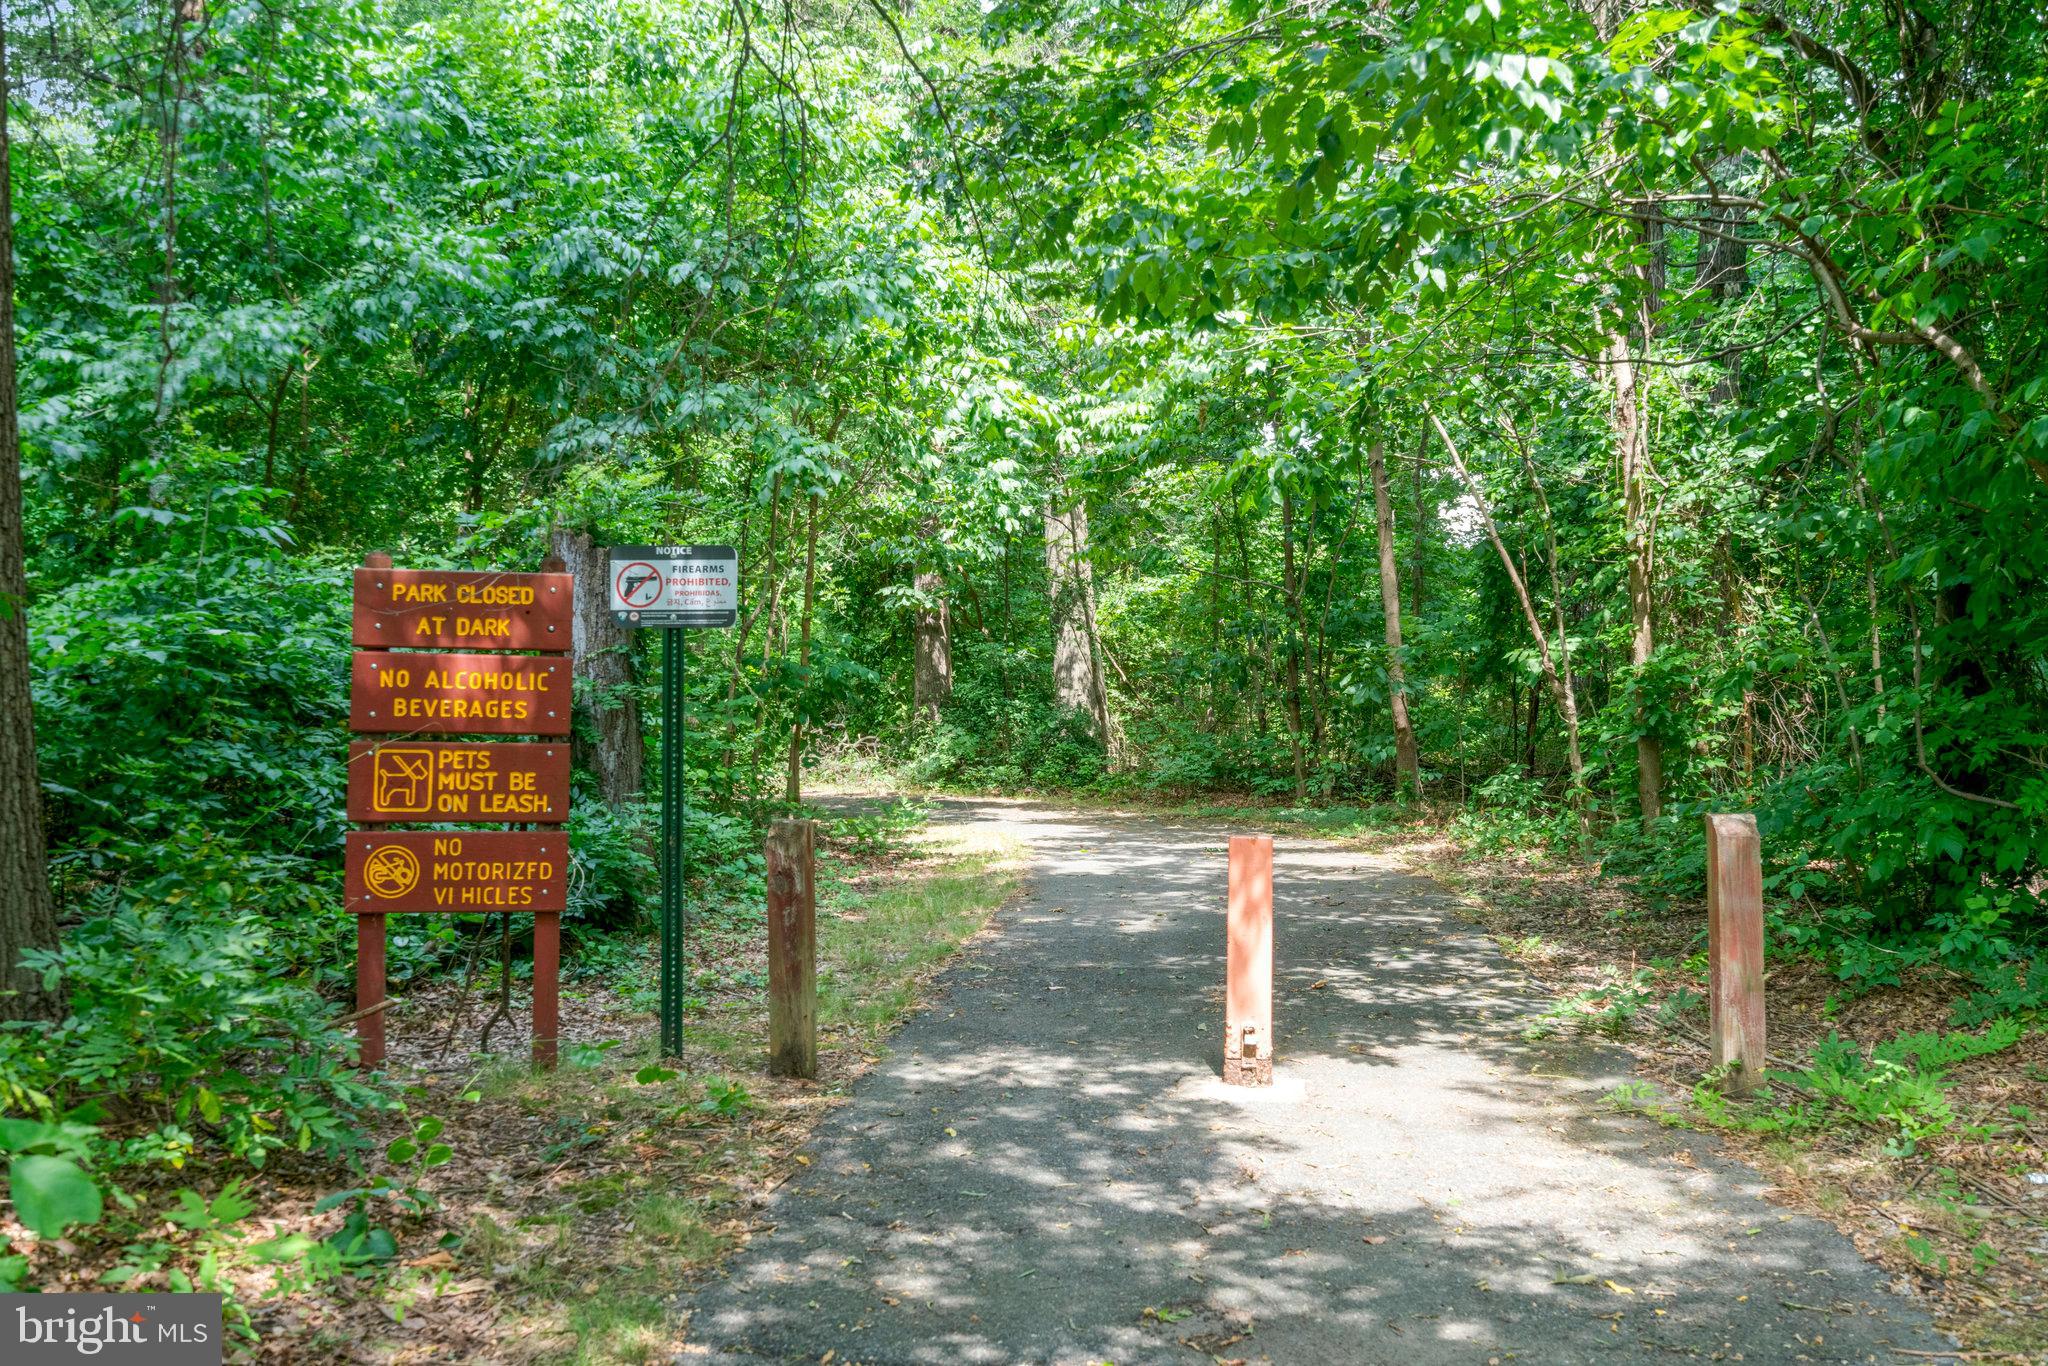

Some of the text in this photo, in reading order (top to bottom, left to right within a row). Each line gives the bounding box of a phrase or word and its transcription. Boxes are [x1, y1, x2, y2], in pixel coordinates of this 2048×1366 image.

[656, 546, 692, 555] NOTICE
[672, 565, 725, 573] FIREARMS
[665, 578, 731, 587] PROHIBITED,
[392, 583, 535, 605] PARK CLOSED
[416, 616, 510, 637] AT DARK
[379, 668, 549, 692] NO ALCOHOLIC
[393, 697, 528, 719] BEVERAGES
[438, 749, 491, 769] PETS
[438, 771, 537, 791] MUST BE
[438, 793, 548, 813] ON LEASH
[434, 838, 462, 856] NO
